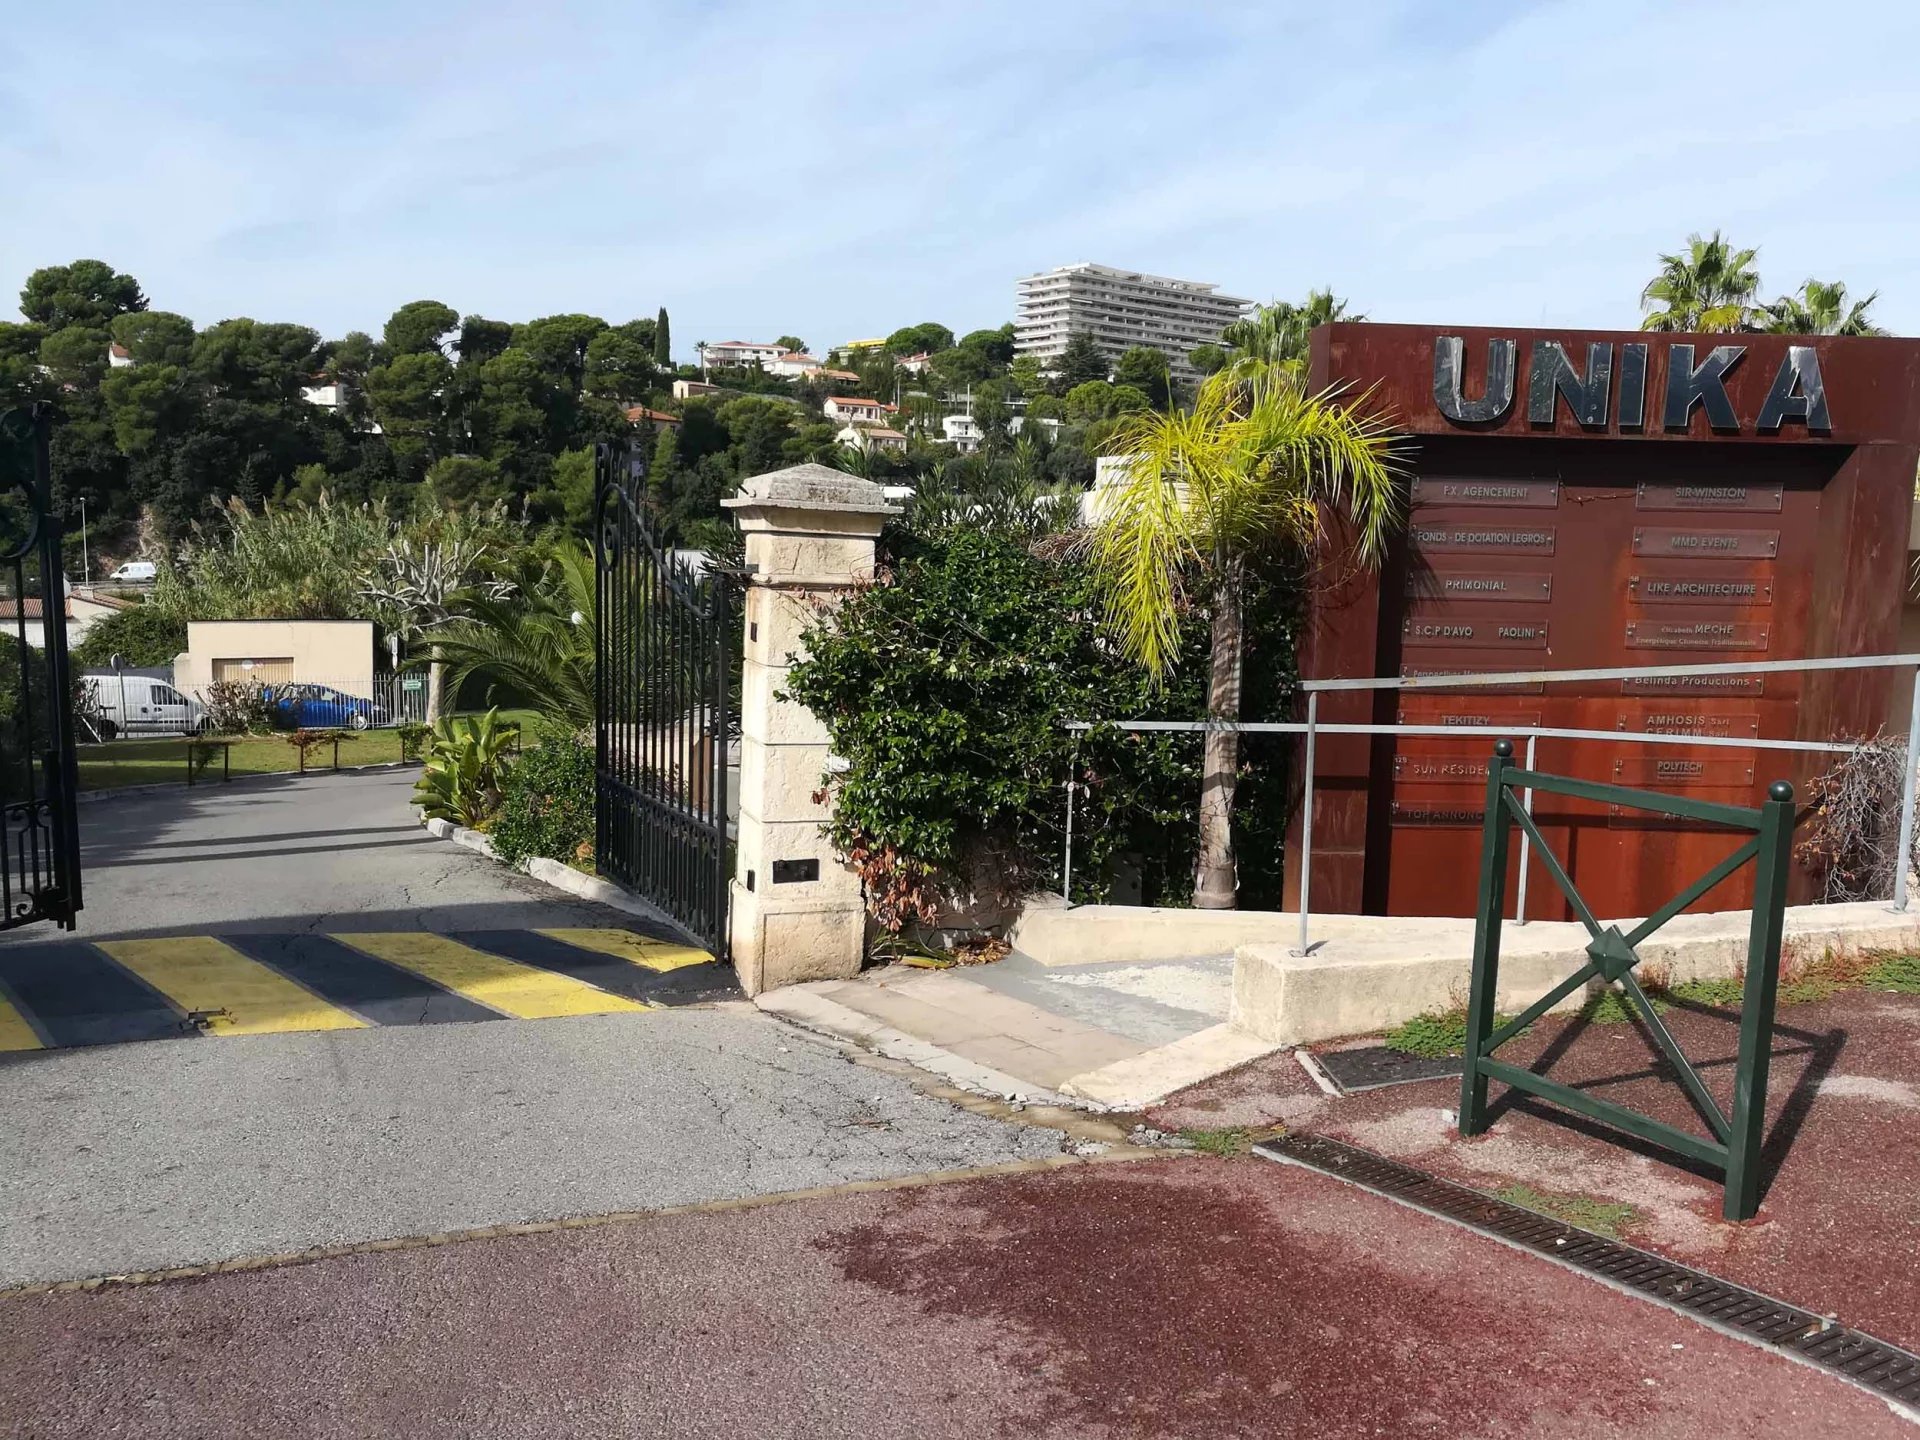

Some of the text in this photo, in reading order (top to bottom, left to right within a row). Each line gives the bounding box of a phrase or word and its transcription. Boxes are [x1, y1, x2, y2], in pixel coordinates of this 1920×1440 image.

[1434, 336, 1832, 429] UNIKA
[1463, 486, 1528, 498] AGENCEMENT
[1417, 531, 1447, 542] FONDS
[1455, 532, 1466, 542] DE
[1468, 532, 1510, 543] DOTATION
[1512, 533, 1546, 543] LEGROS
[1671, 536, 1738, 548] MMD EVENTS
[1445, 580, 1507, 591] PRIMONIAL
[1647, 582, 1756, 594] LIKE ARCHITECTURE
[1498, 627, 1535, 638] PAOLINI
[1635, 674, 1751, 686] Belinda Productions
[1441, 715, 1490, 726] TEKITIZY
[1647, 715, 1706, 725] AMHOSIS
[1413, 764, 1437, 774] SUN
[1657, 761, 1703, 771] POLYTECH
